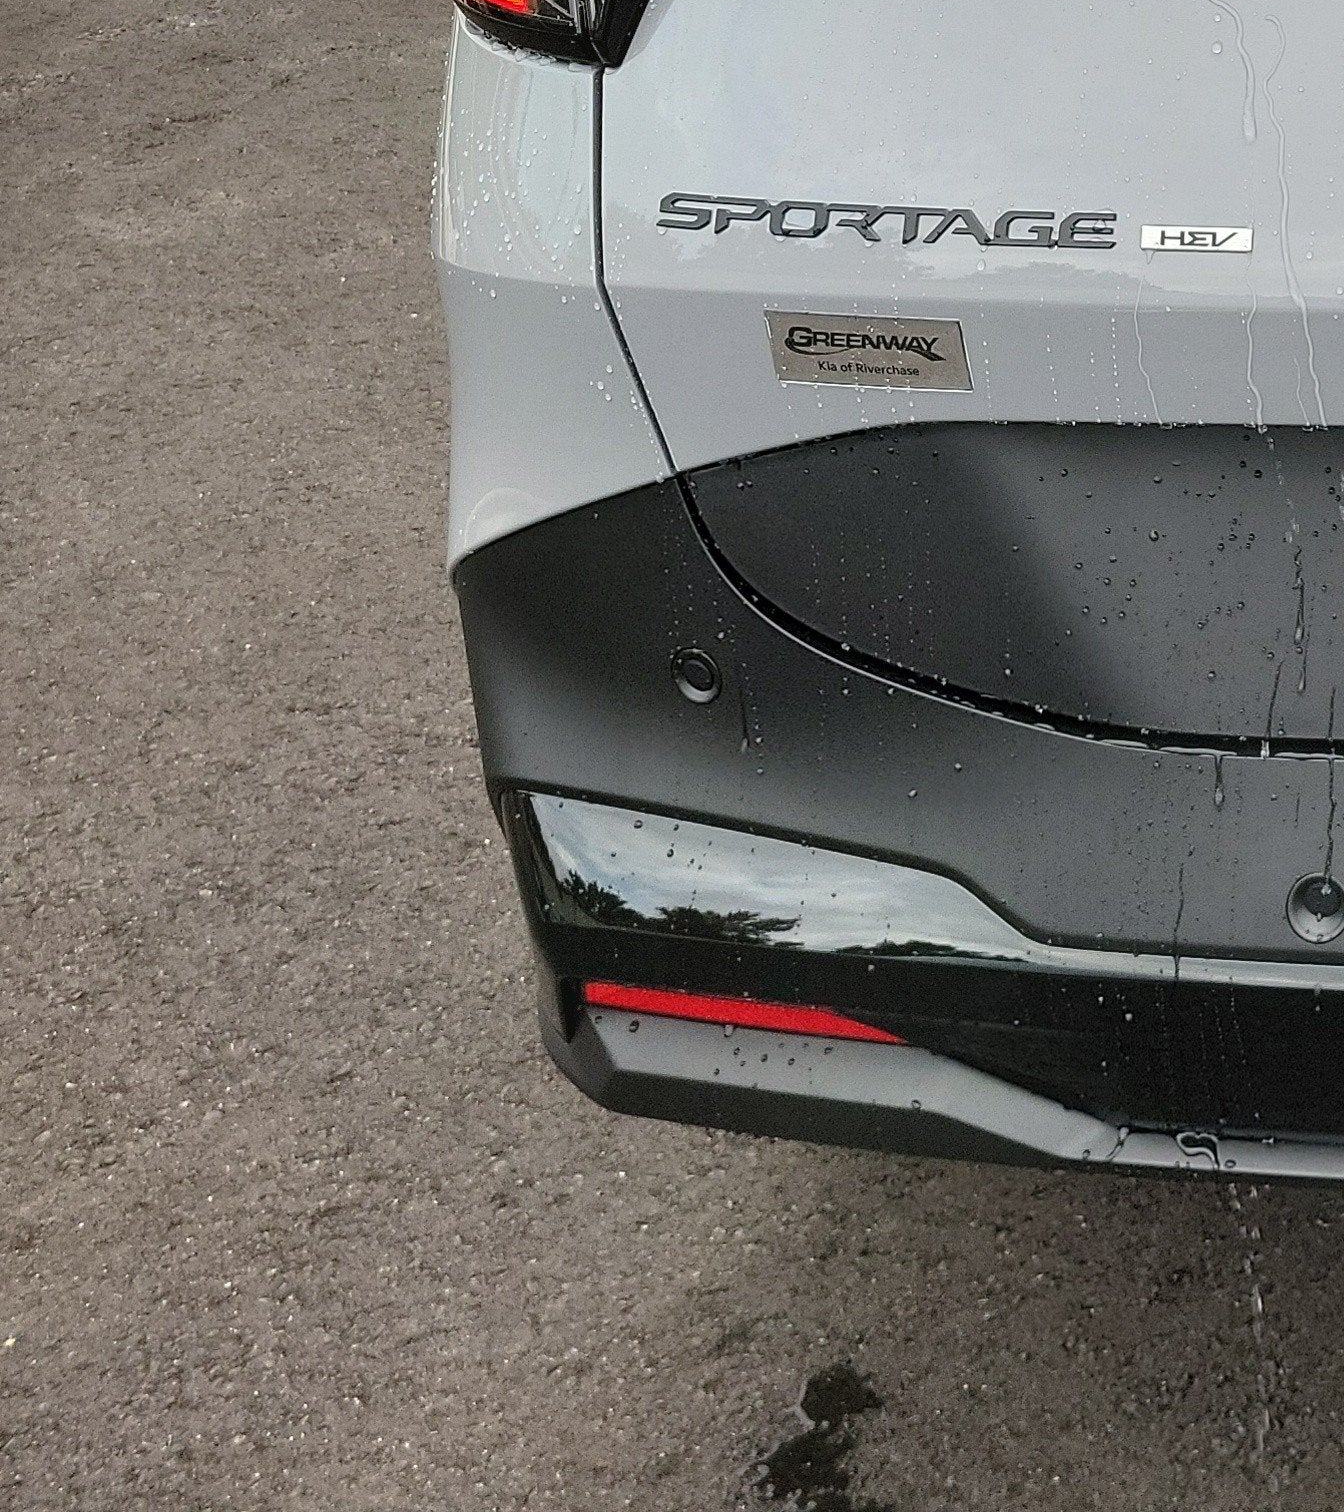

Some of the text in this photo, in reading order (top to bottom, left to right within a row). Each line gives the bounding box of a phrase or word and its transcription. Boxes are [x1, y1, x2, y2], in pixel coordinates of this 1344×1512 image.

[656, 191, 1118, 250] SPORTAGE
[1160, 230, 1238, 247] HEV
[786, 326, 940, 353] GREENWAY
[817, 360, 920, 377] Kia of Riverchase
